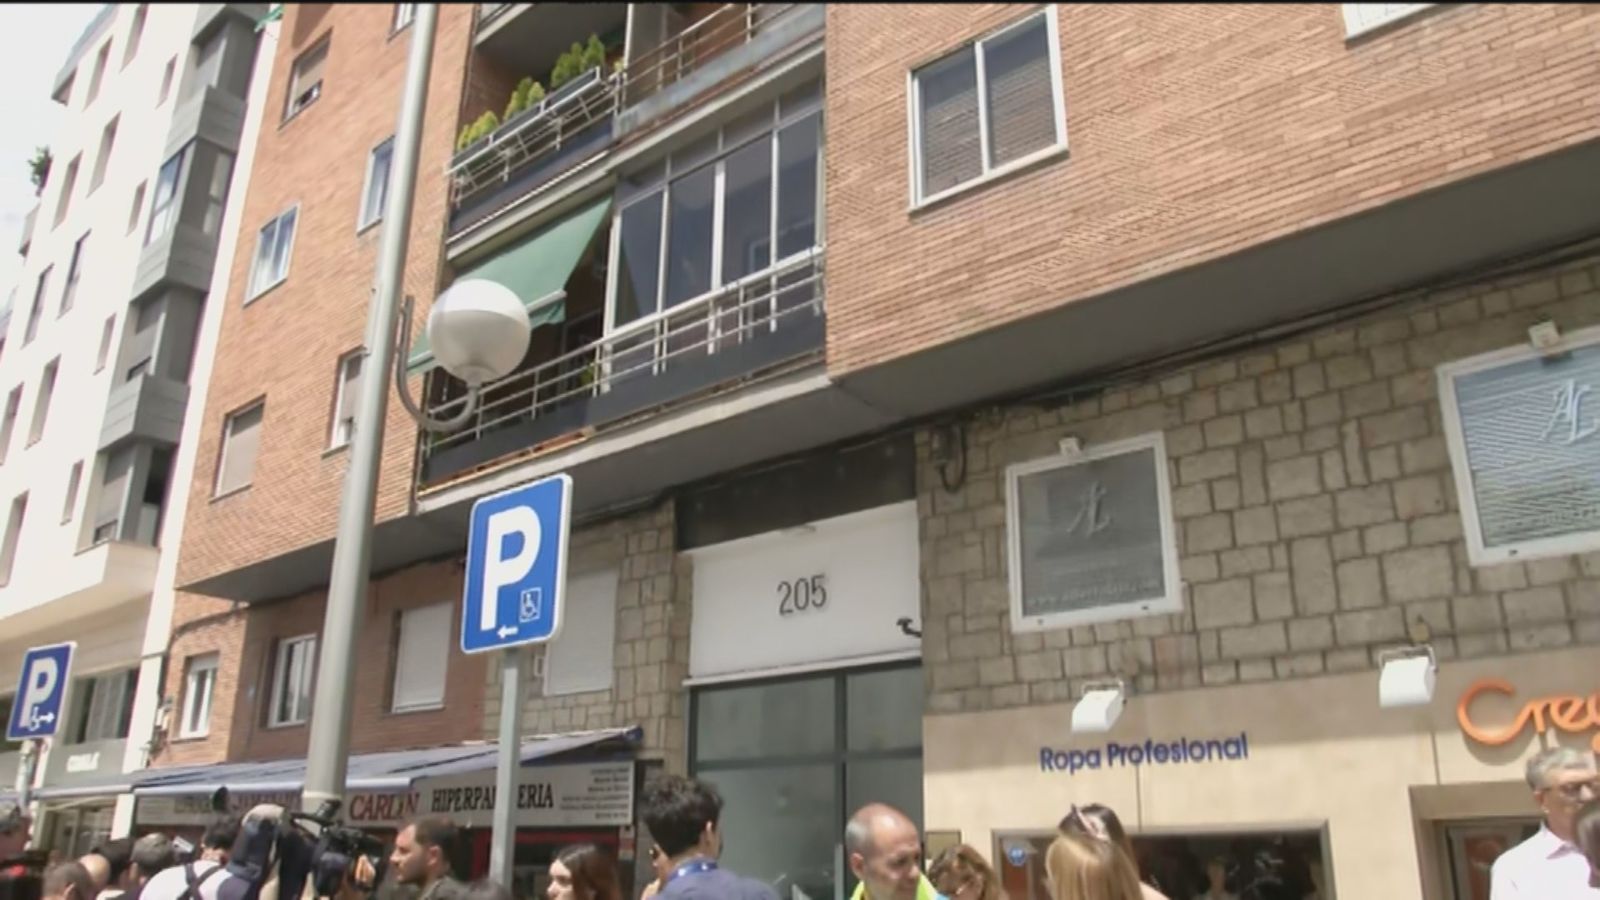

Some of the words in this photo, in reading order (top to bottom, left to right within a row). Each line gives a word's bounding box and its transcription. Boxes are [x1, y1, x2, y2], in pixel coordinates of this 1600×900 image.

[480, 505, 542, 631] P
[777, 573, 827, 616] 205
[19, 657, 58, 728] P
[1040, 746, 1101, 775] Ropa
[1106, 731, 1249, 767] Profesional
[430, 783, 554, 813] HIPERPAERIA
